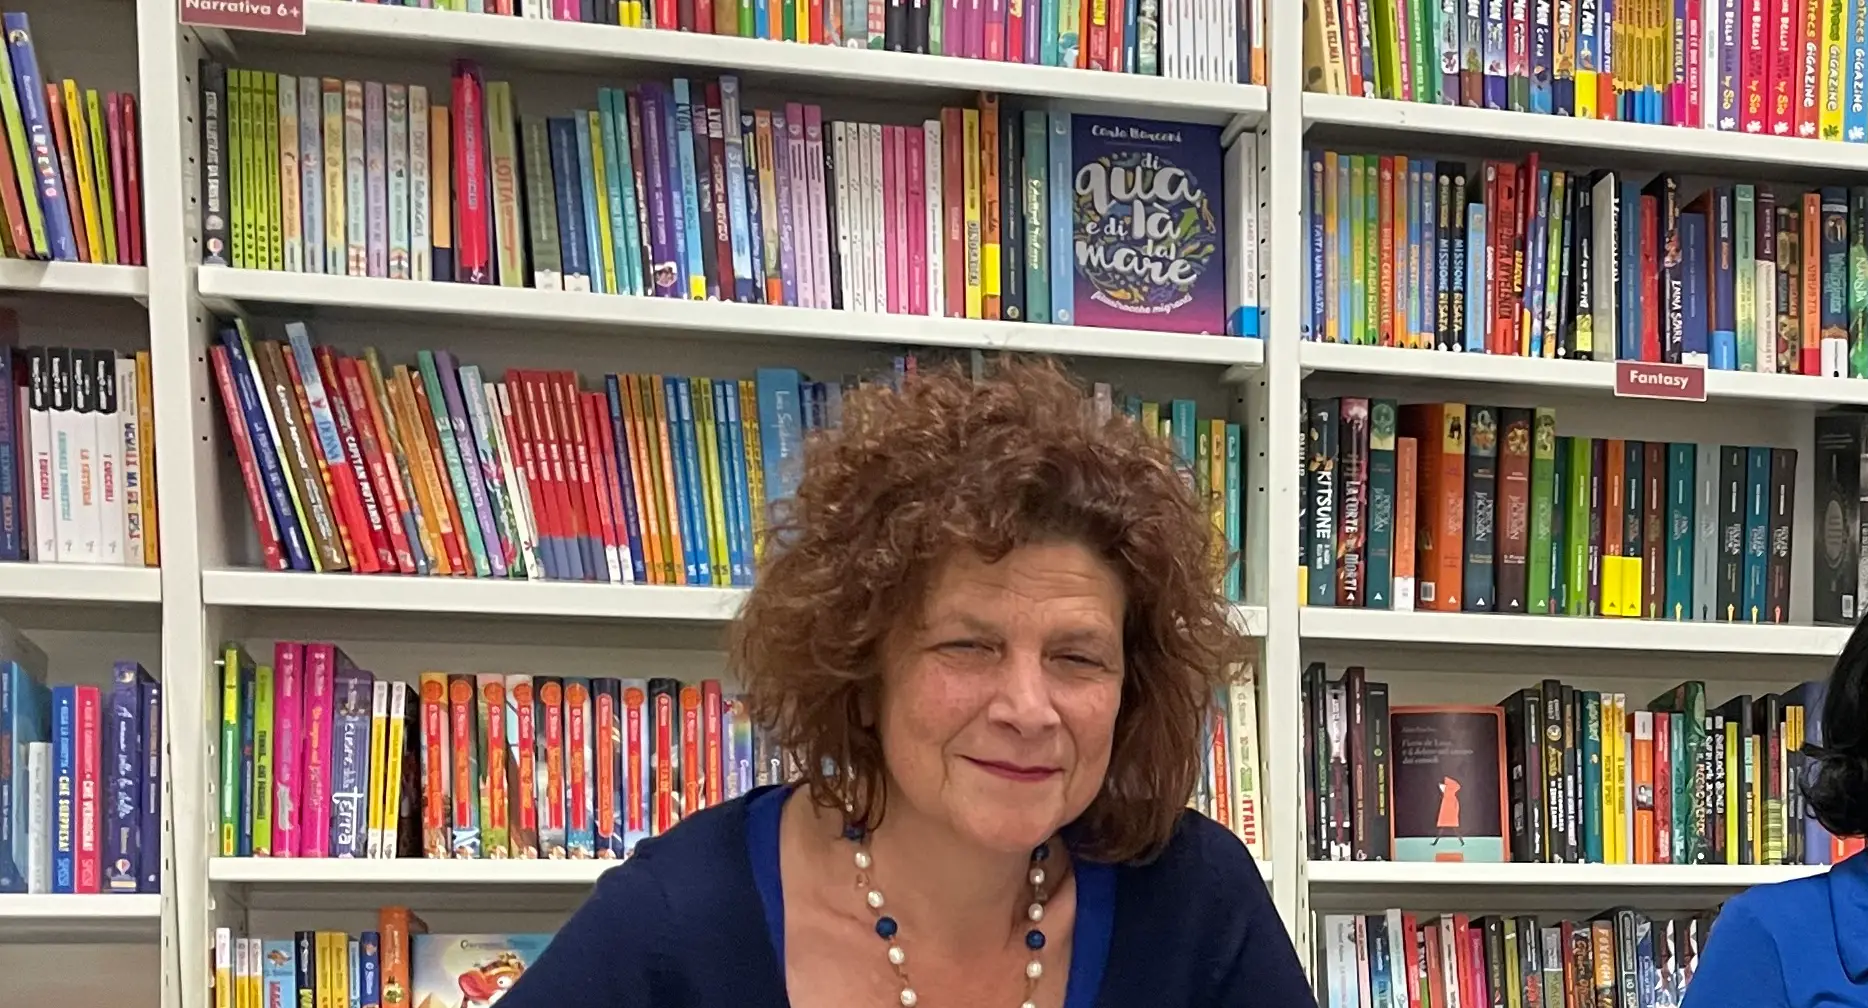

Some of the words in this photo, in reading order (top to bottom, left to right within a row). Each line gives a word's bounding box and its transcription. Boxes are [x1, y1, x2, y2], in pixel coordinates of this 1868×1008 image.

[186, 0, 271, 15] Narrativa
[277, 4, 300, 18] 6+
[1722, 89, 1734, 109] Sio
[1749, 93, 1760, 114] Sio
[1776, 94, 1788, 114] Sio
[707, 108, 723, 138] LYON
[1141, 153, 1160, 169] di
[1076, 163, 1201, 215] qua
[1086, 221, 1100, 234] e
[1104, 218, 1128, 236] di
[1132, 199, 1181, 239] là
[1076, 240, 1197, 284] mare
[1142, 239, 1176, 260] dal
[1439, 239, 1449, 291] MISSIONE
[1453, 239, 1463, 291] MISSIONE
[1854, 256, 1867, 302] NARNIA
[1438, 293, 1448, 332] RISATA
[1453, 293, 1463, 332] RISATA
[1629, 370, 1689, 388] Fantasy
[1316, 470, 1332, 538] KITSUNE
[332, 785, 365, 851] terra
[1596, 928, 1614, 985] FOXLIGHT
